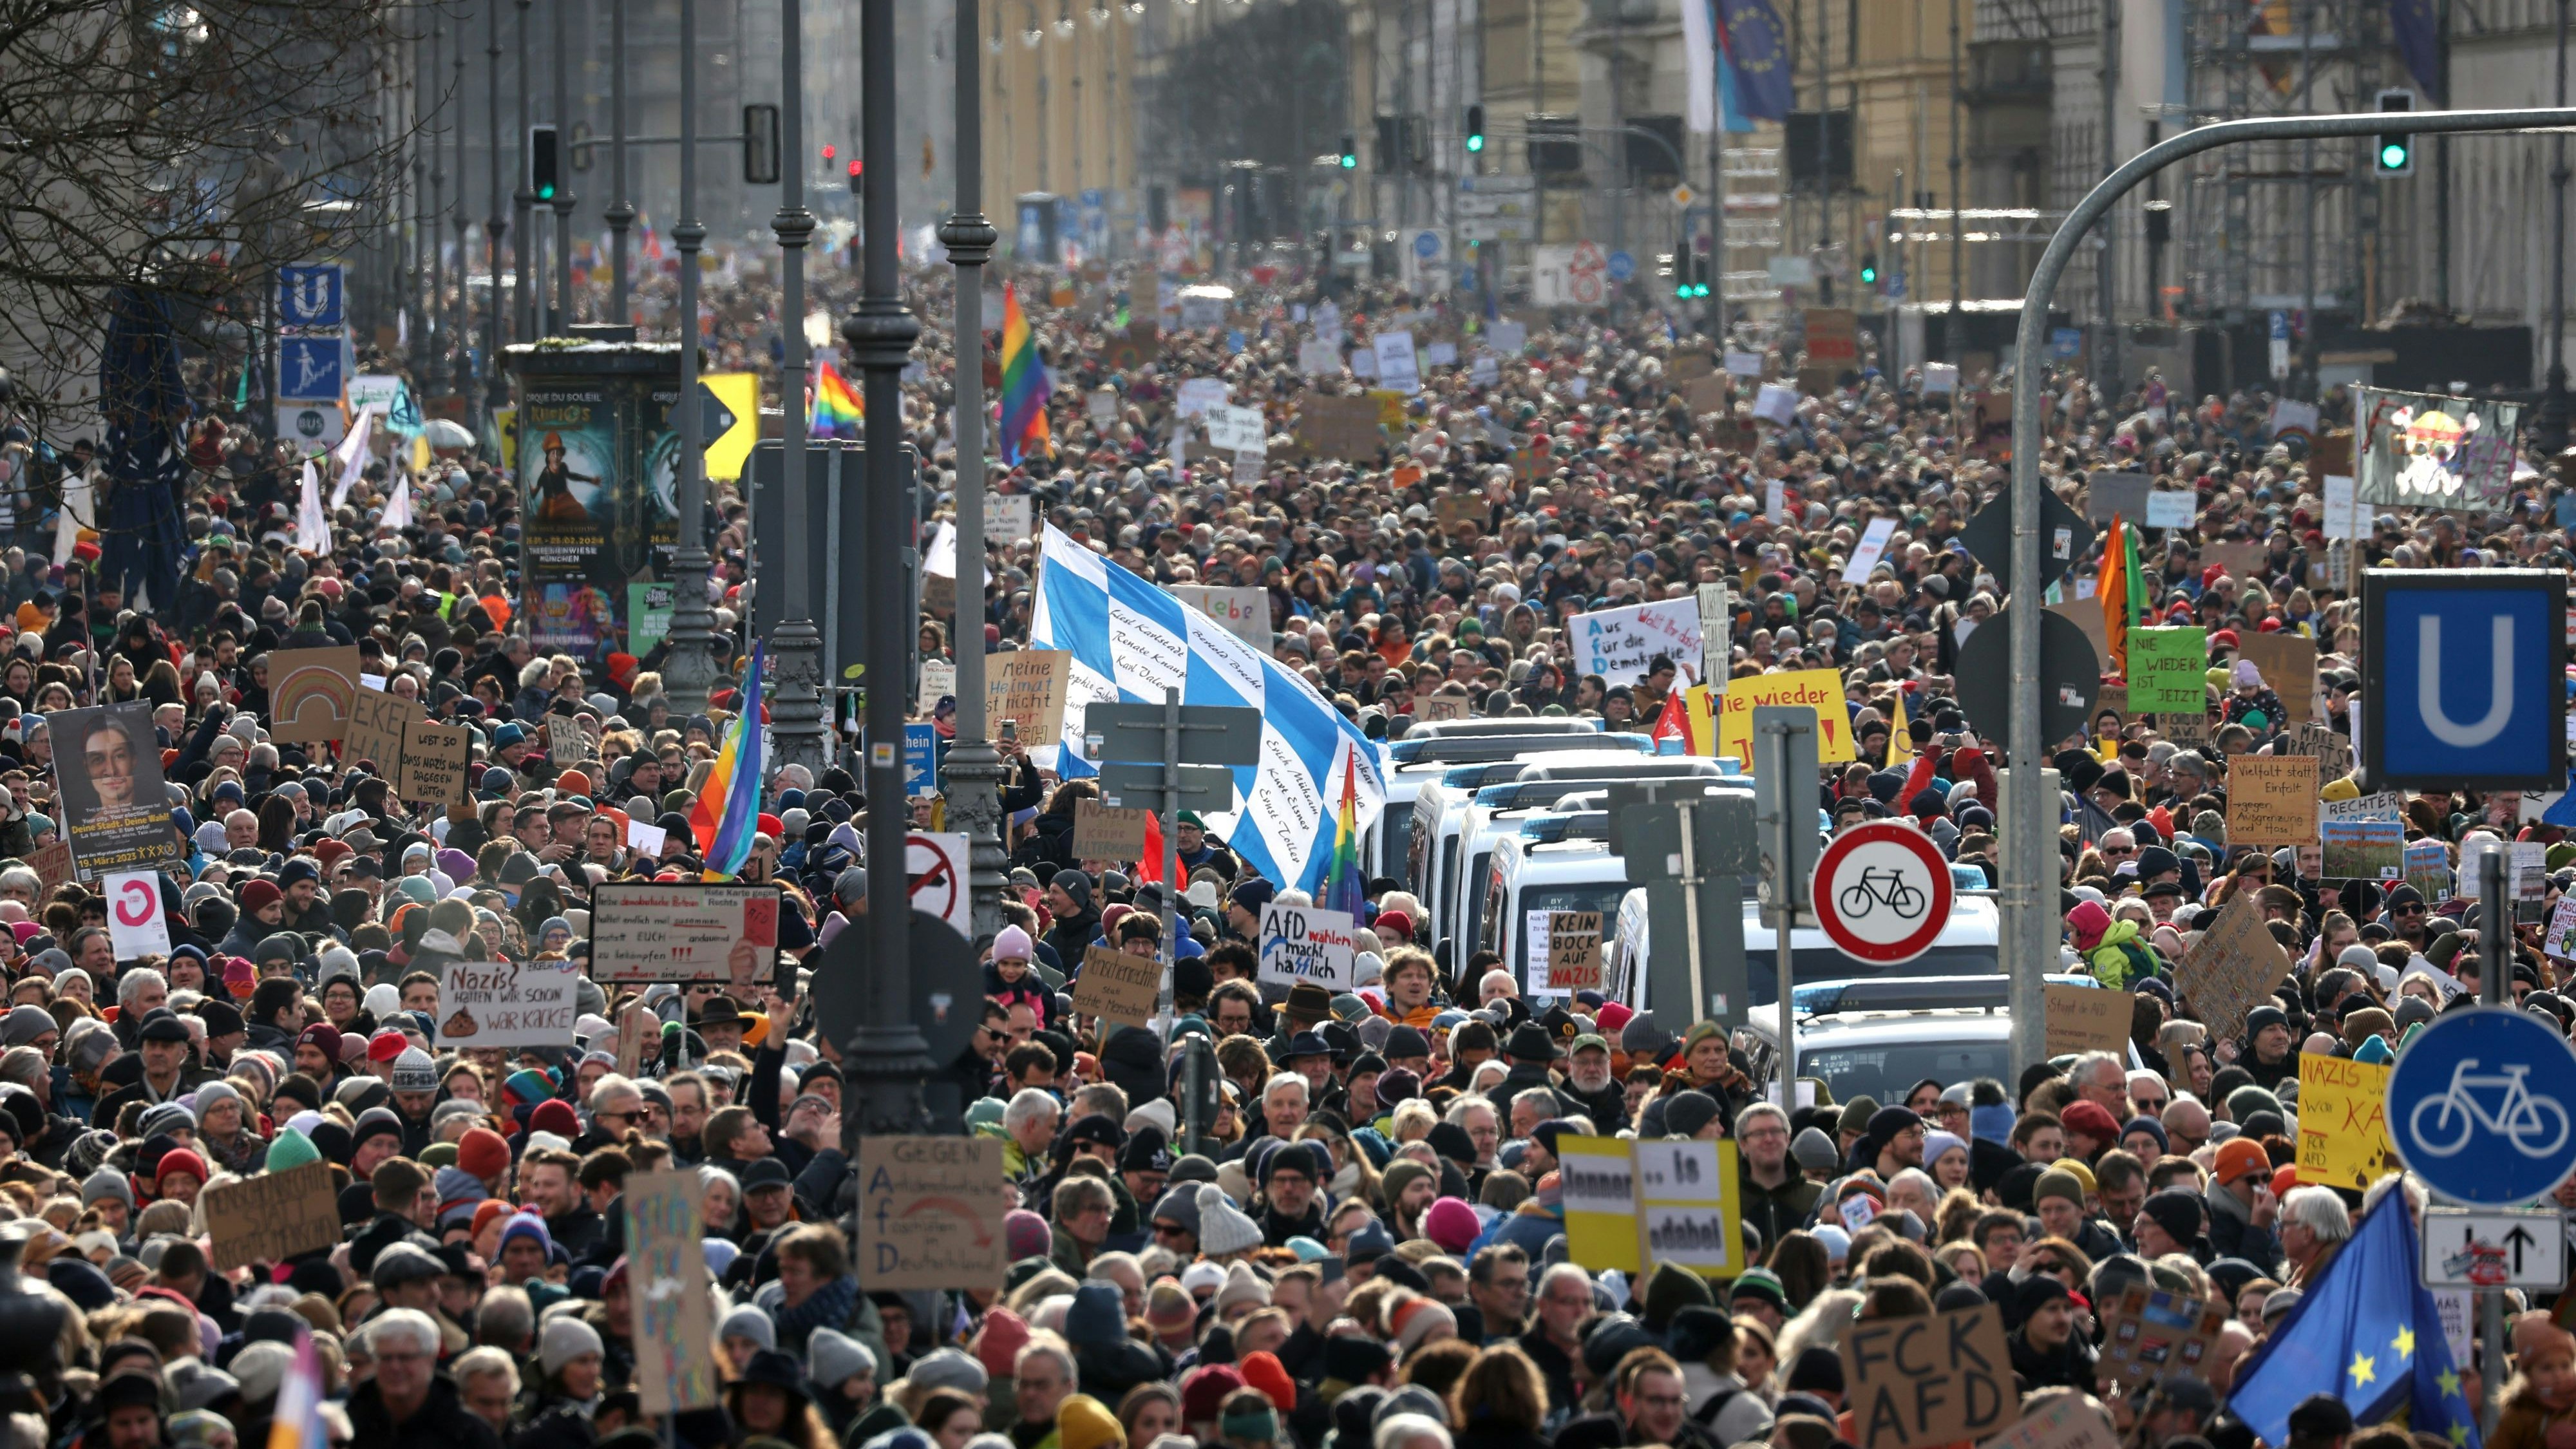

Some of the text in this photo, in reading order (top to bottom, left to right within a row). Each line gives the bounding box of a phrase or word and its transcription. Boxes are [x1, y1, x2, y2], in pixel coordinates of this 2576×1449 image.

[294, 274, 328, 317] U
[299, 419, 323, 428] BUS
[1204, 592, 1253, 619] Lebe
[1109, 609, 1185, 658] Liesl Karlstadt
[1588, 618, 1620, 636] Aus
[1112, 630, 1188, 678] Renate Knaup
[1592, 633, 1645, 656] für die
[2136, 638, 2157, 652] NIE
[1193, 628, 1263, 690] Bertold Brecht
[2145, 658, 2199, 672] WIEDER
[1003, 661, 1050, 677] Meine
[1116, 654, 1170, 692] Karl Valen
[990, 677, 1053, 695] Heimat
[1068, 667, 1094, 691] ophie
[2136, 676, 2155, 688] IST
[2418, 615, 2514, 748] U
[985, 693, 1052, 713] st nicht
[1703, 683, 1828, 718] Nie wieder
[2157, 690, 2200, 703] JETZT
[552, 719, 581, 741] EKEL
[2301, 726, 2335, 747] MAKE
[419, 734, 458, 746] LEBT SO
[906, 733, 929, 748] hein
[402, 752, 464, 772] DASS NAZIS WAS
[1352, 751, 1375, 785] Oskar
[413, 770, 452, 784] DAGEGEN
[1266, 739, 1319, 815] Erich Mühsam
[2238, 764, 2282, 782] Vielfalt
[2287, 765, 2312, 778] statt
[2266, 781, 2302, 797] Einfalt
[1266, 767, 1310, 831] Kurt Eisner
[2241, 802, 2273, 813] gegen
[2329, 793, 2398, 815] RECHTER
[72, 824, 96, 834] Deine
[125, 818, 147, 826] Deine
[149, 813, 170, 822] Wahl!
[1259, 788, 1300, 864] Ernst Toller
[2235, 824, 2254, 832] und
[78, 853, 137, 868] 19. März 2023
[726, 888, 750, 896] Karte
[708, 898, 739, 907] Rechts
[623, 914, 650, 925] endlich
[1264, 909, 1306, 941] AfD
[1553, 914, 1597, 933] KEIN
[637, 932, 666, 942] EUCH
[1308, 929, 1351, 947] wählen
[1553, 935, 1596, 950] BOCK
[2548, 934, 2562, 945] GEN
[1285, 942, 1324, 958] macht
[1559, 951, 1589, 965] AUF
[451, 962, 520, 992] Nazis?
[661, 968, 677, 979] sind
[1087, 947, 1157, 990] Menschenrechte
[1550, 966, 1598, 987] NAZIS
[2302, 1058, 2360, 1088] NAZIS
[893, 1141, 981, 1164] GEGEN
[2307, 1136, 2325, 1150] FCK
[2304, 1152, 2326, 1167] AFD
[1851, 1312, 1992, 1385] FCK
[1867, 1369, 2003, 1448] AFD
